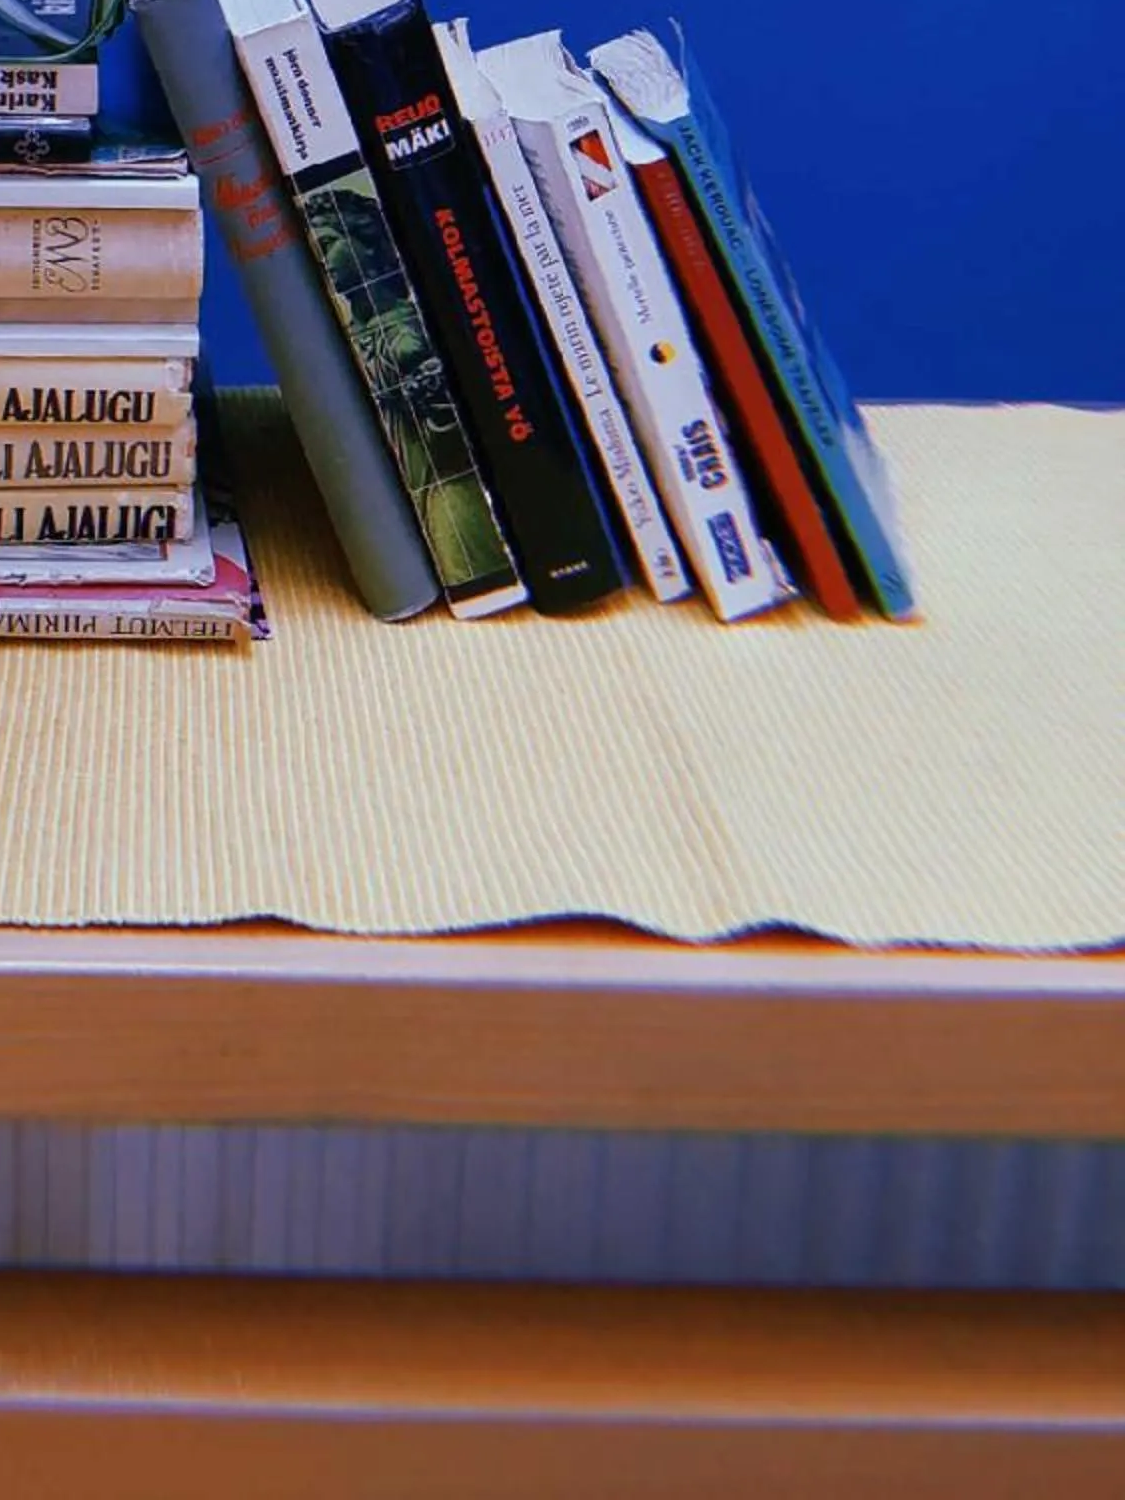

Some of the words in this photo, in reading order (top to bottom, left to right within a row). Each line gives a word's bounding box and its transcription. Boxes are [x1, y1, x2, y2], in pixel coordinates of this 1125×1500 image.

[384, 117, 451, 161] MÄKI
[678, 123, 707, 168] JACK
[699, 167, 745, 251] KEROUAC
[434, 207, 515, 401] KOLMASTOISTA
[1, 387, 156, 424] AJALUGU
[24, 440, 173, 479] AJALUGU
[110, 612, 233, 637] HELMUT
